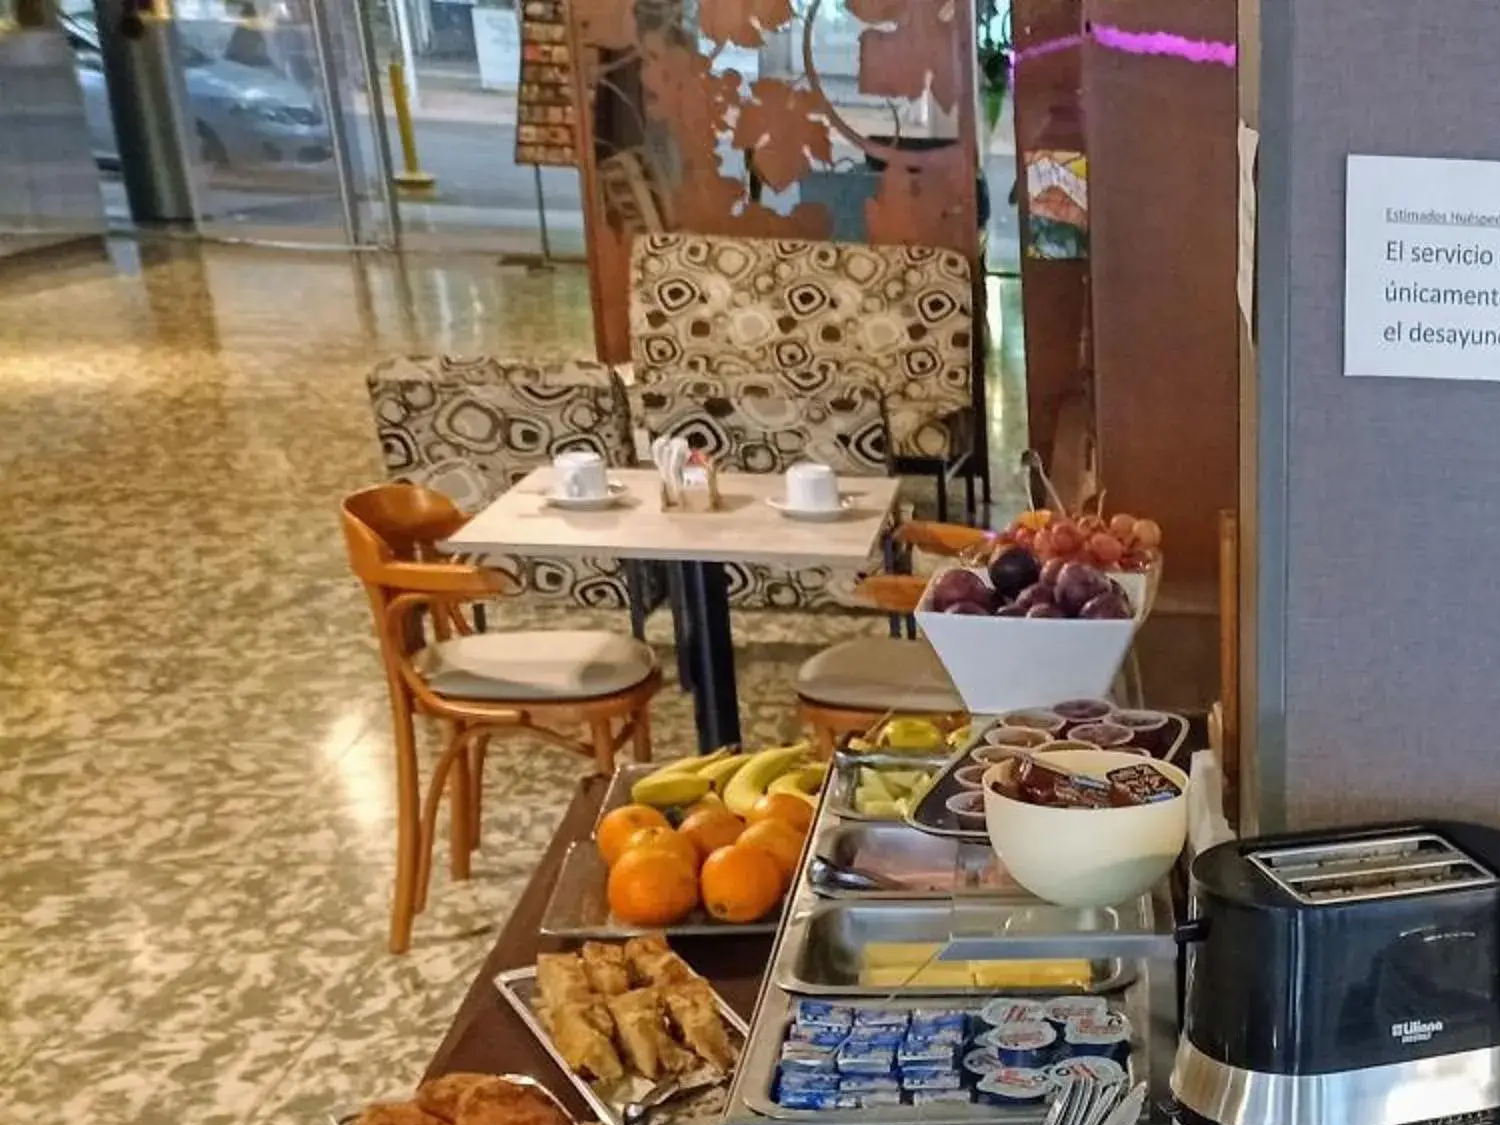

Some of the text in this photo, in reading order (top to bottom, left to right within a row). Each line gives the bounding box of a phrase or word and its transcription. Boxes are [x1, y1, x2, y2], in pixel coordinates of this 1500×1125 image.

[1386, 240, 1403, 263] El
[1411, 243, 1493, 265] servicio
[1383, 321, 1401, 342] el
